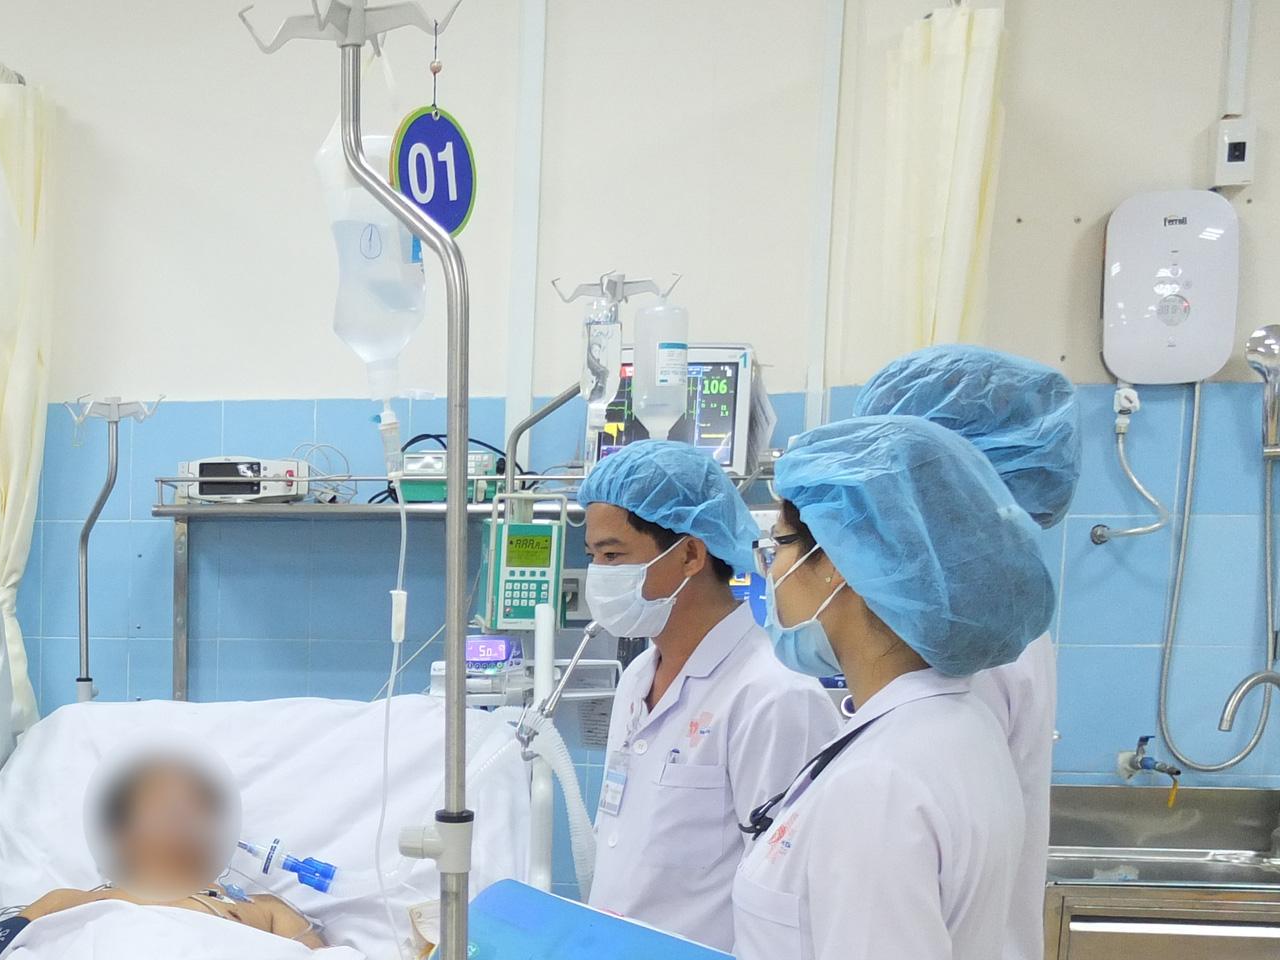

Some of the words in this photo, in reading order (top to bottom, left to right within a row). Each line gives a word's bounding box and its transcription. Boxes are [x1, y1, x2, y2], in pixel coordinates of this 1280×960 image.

[408, 142, 458, 204] 01
[740, 352, 749, 369] 1
[702, 379, 729, 395] 106
